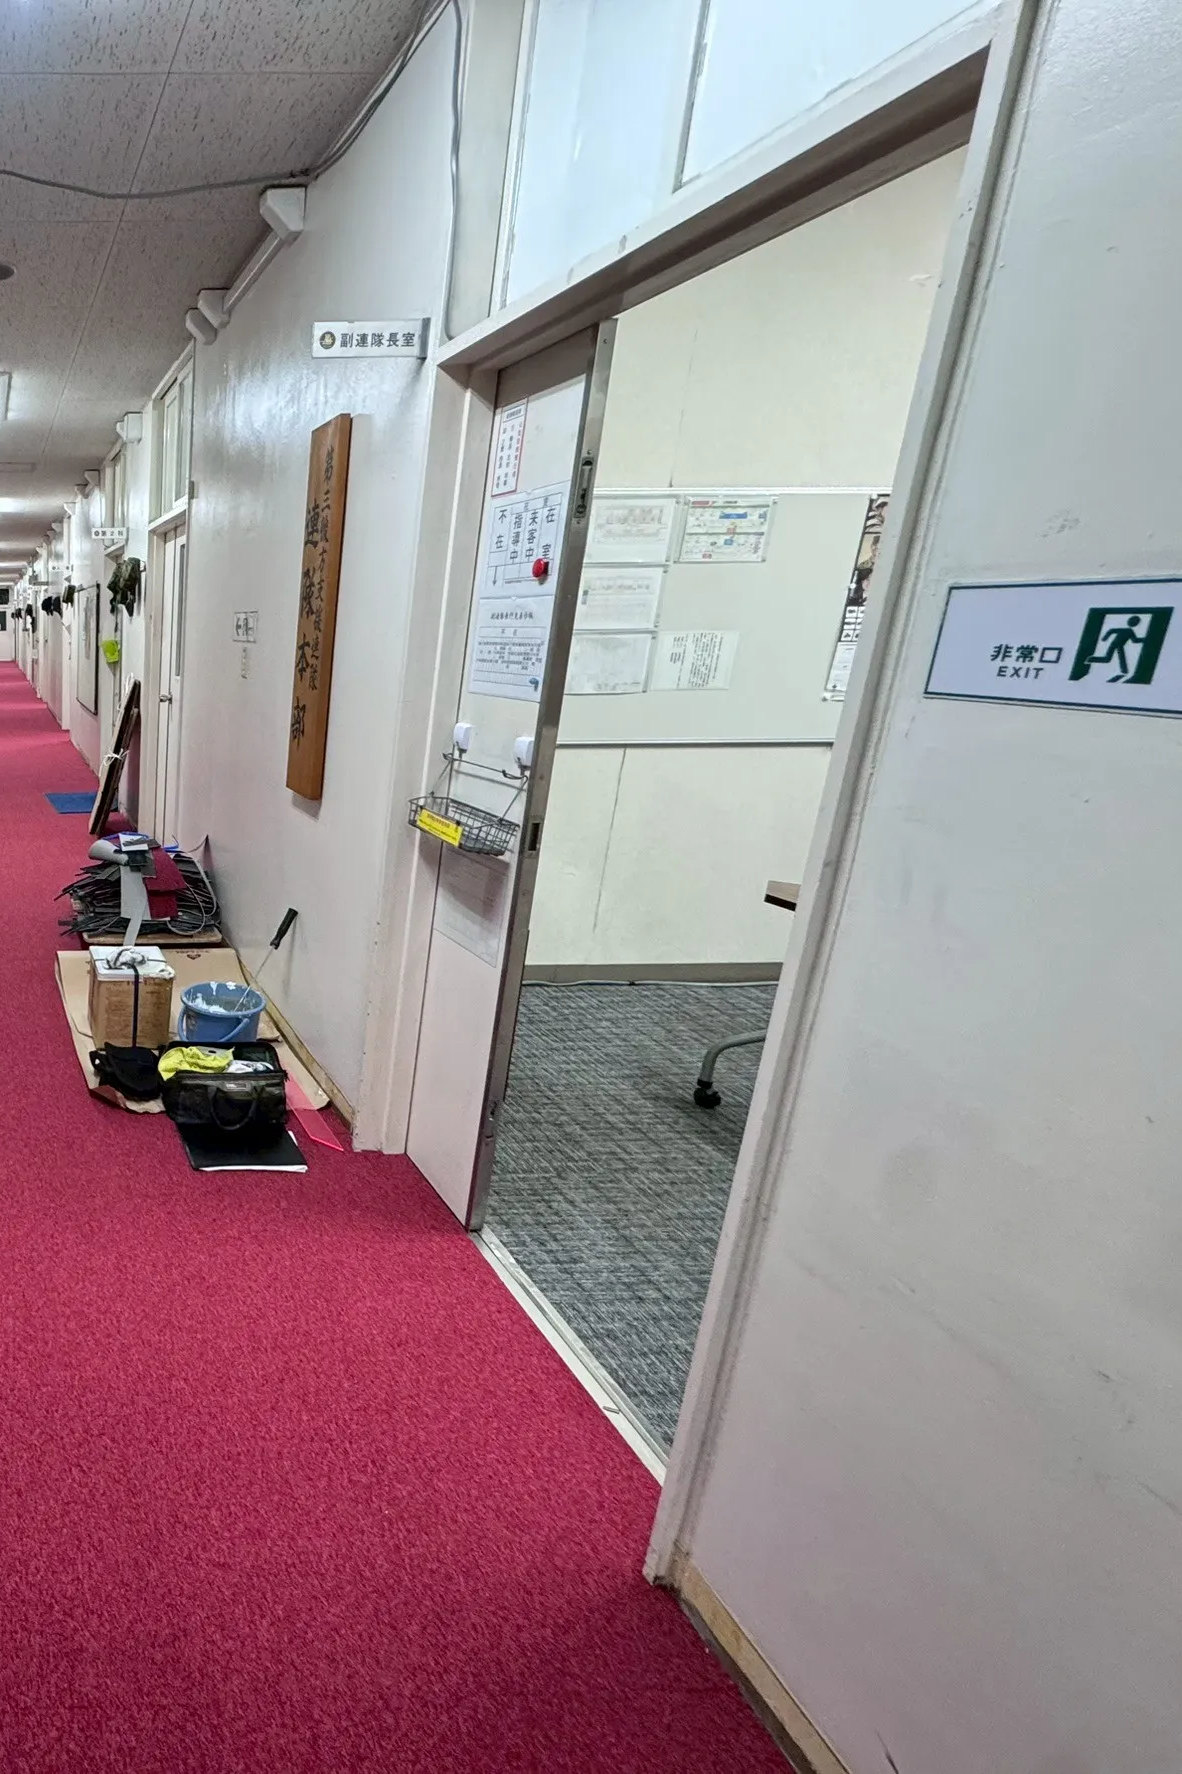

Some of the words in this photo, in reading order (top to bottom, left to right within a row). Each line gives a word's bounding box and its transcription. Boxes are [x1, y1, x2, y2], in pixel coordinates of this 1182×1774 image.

[340, 332, 416, 348] 副連隊長室
[495, 508, 508, 550] 不在
[525, 509, 539, 563] 来客中
[990, 643, 1064, 664] 非常口
[997, 665, 1045, 680] EXIT
